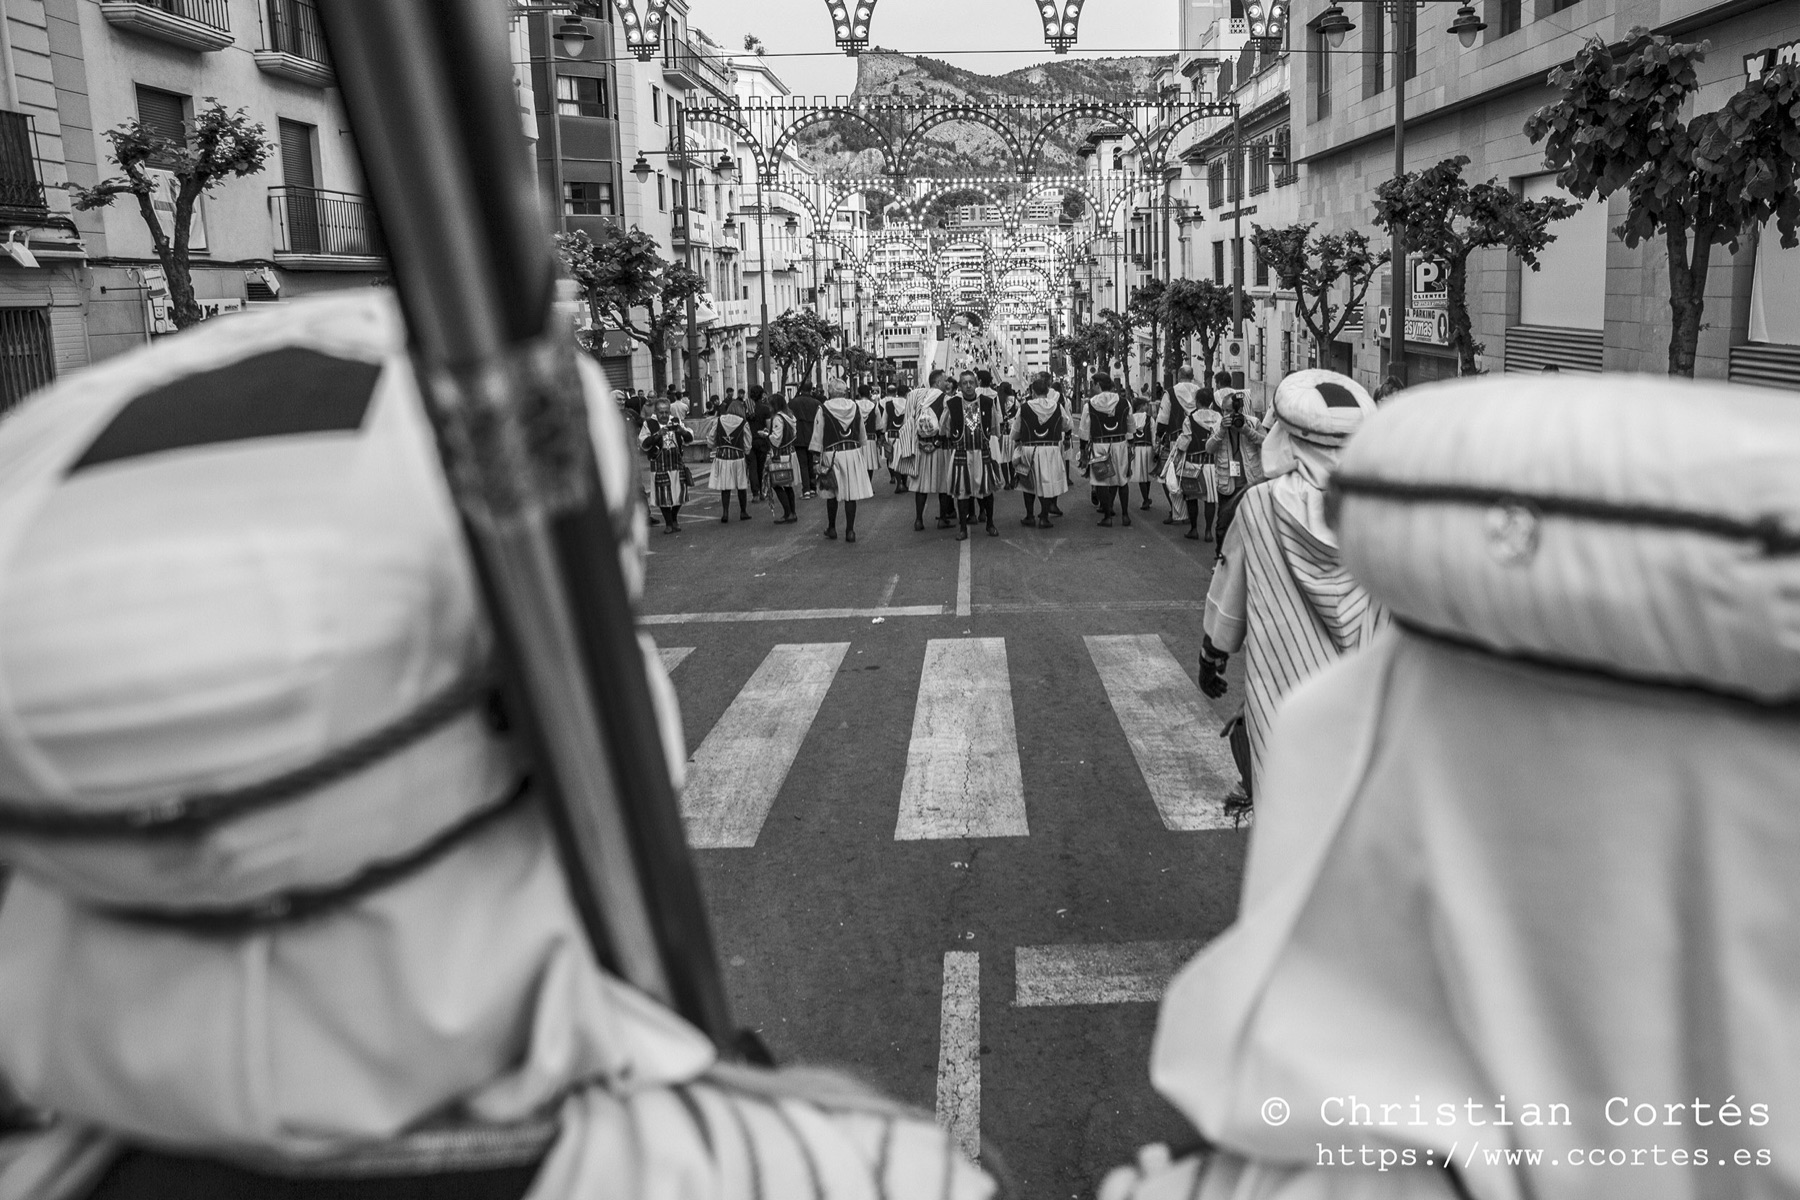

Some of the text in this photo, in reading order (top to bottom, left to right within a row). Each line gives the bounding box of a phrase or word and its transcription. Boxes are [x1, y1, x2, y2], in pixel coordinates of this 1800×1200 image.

[1416, 261, 1439, 292] P
[1413, 309, 1436, 320] PARKING
[1404, 320, 1433, 339] asymas
